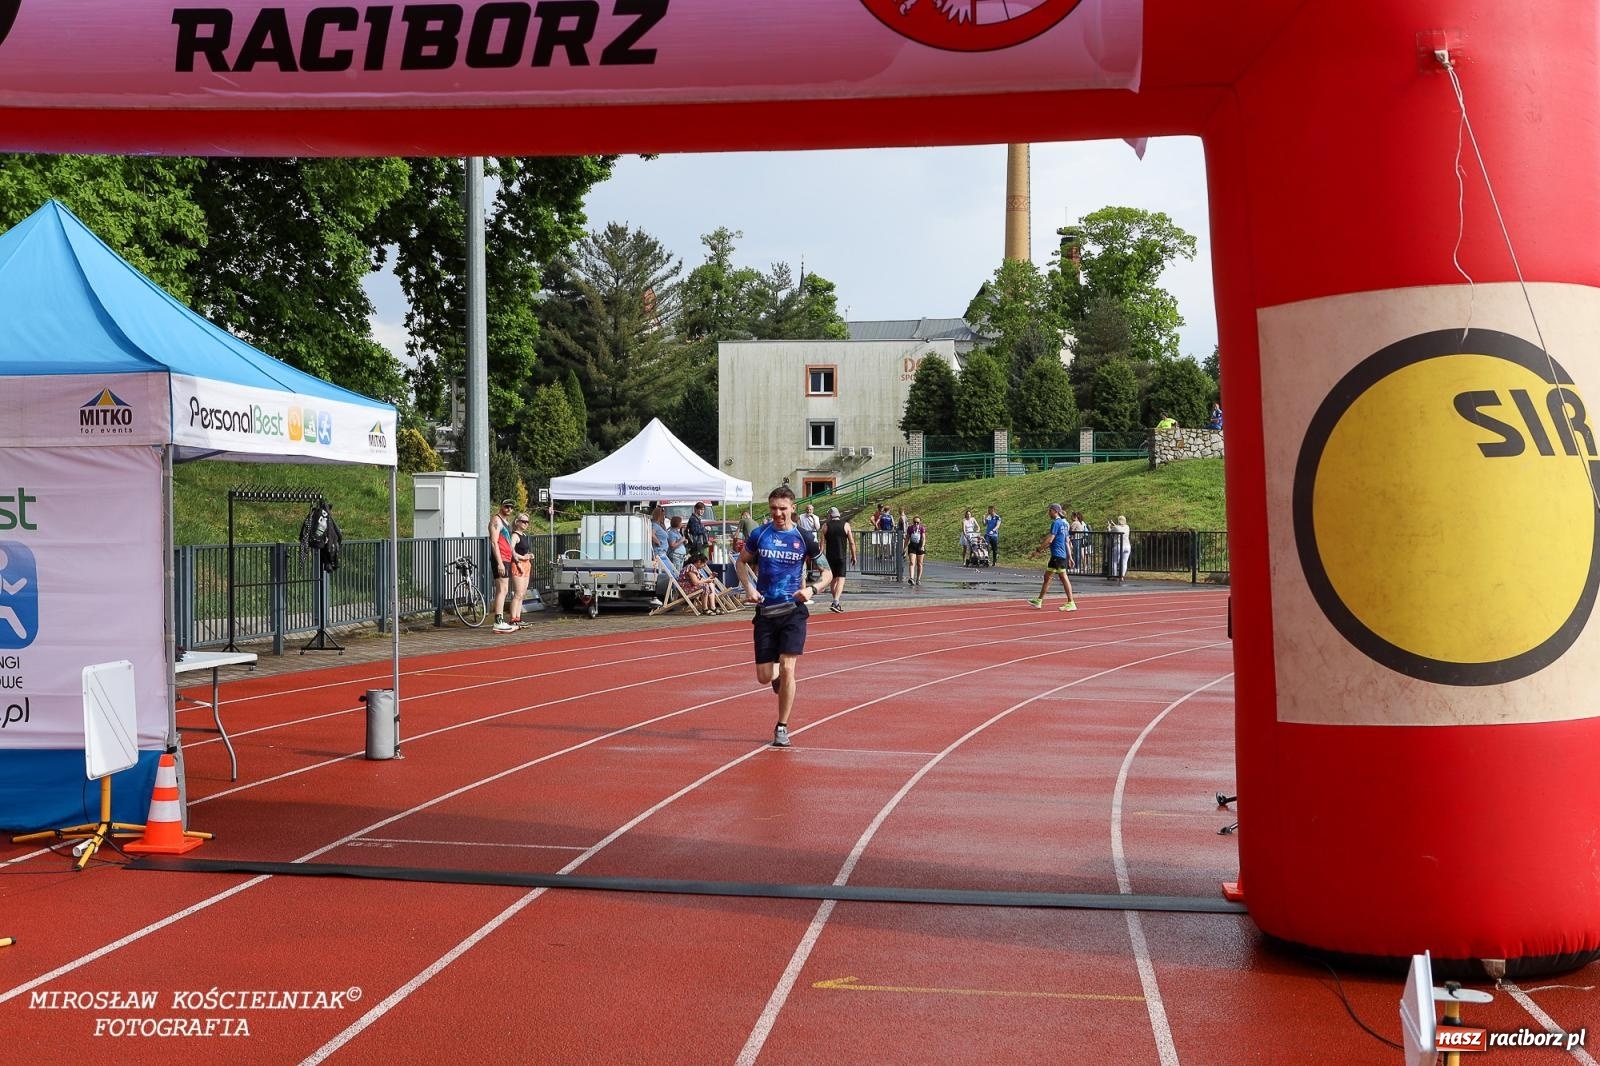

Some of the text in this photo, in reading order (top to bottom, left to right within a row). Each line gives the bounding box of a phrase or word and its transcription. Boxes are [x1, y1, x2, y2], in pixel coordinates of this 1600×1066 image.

[80, 408, 133, 426] MITKO
[189, 396, 284, 436] PersonalBest
[0, 675, 23, 689] WE
